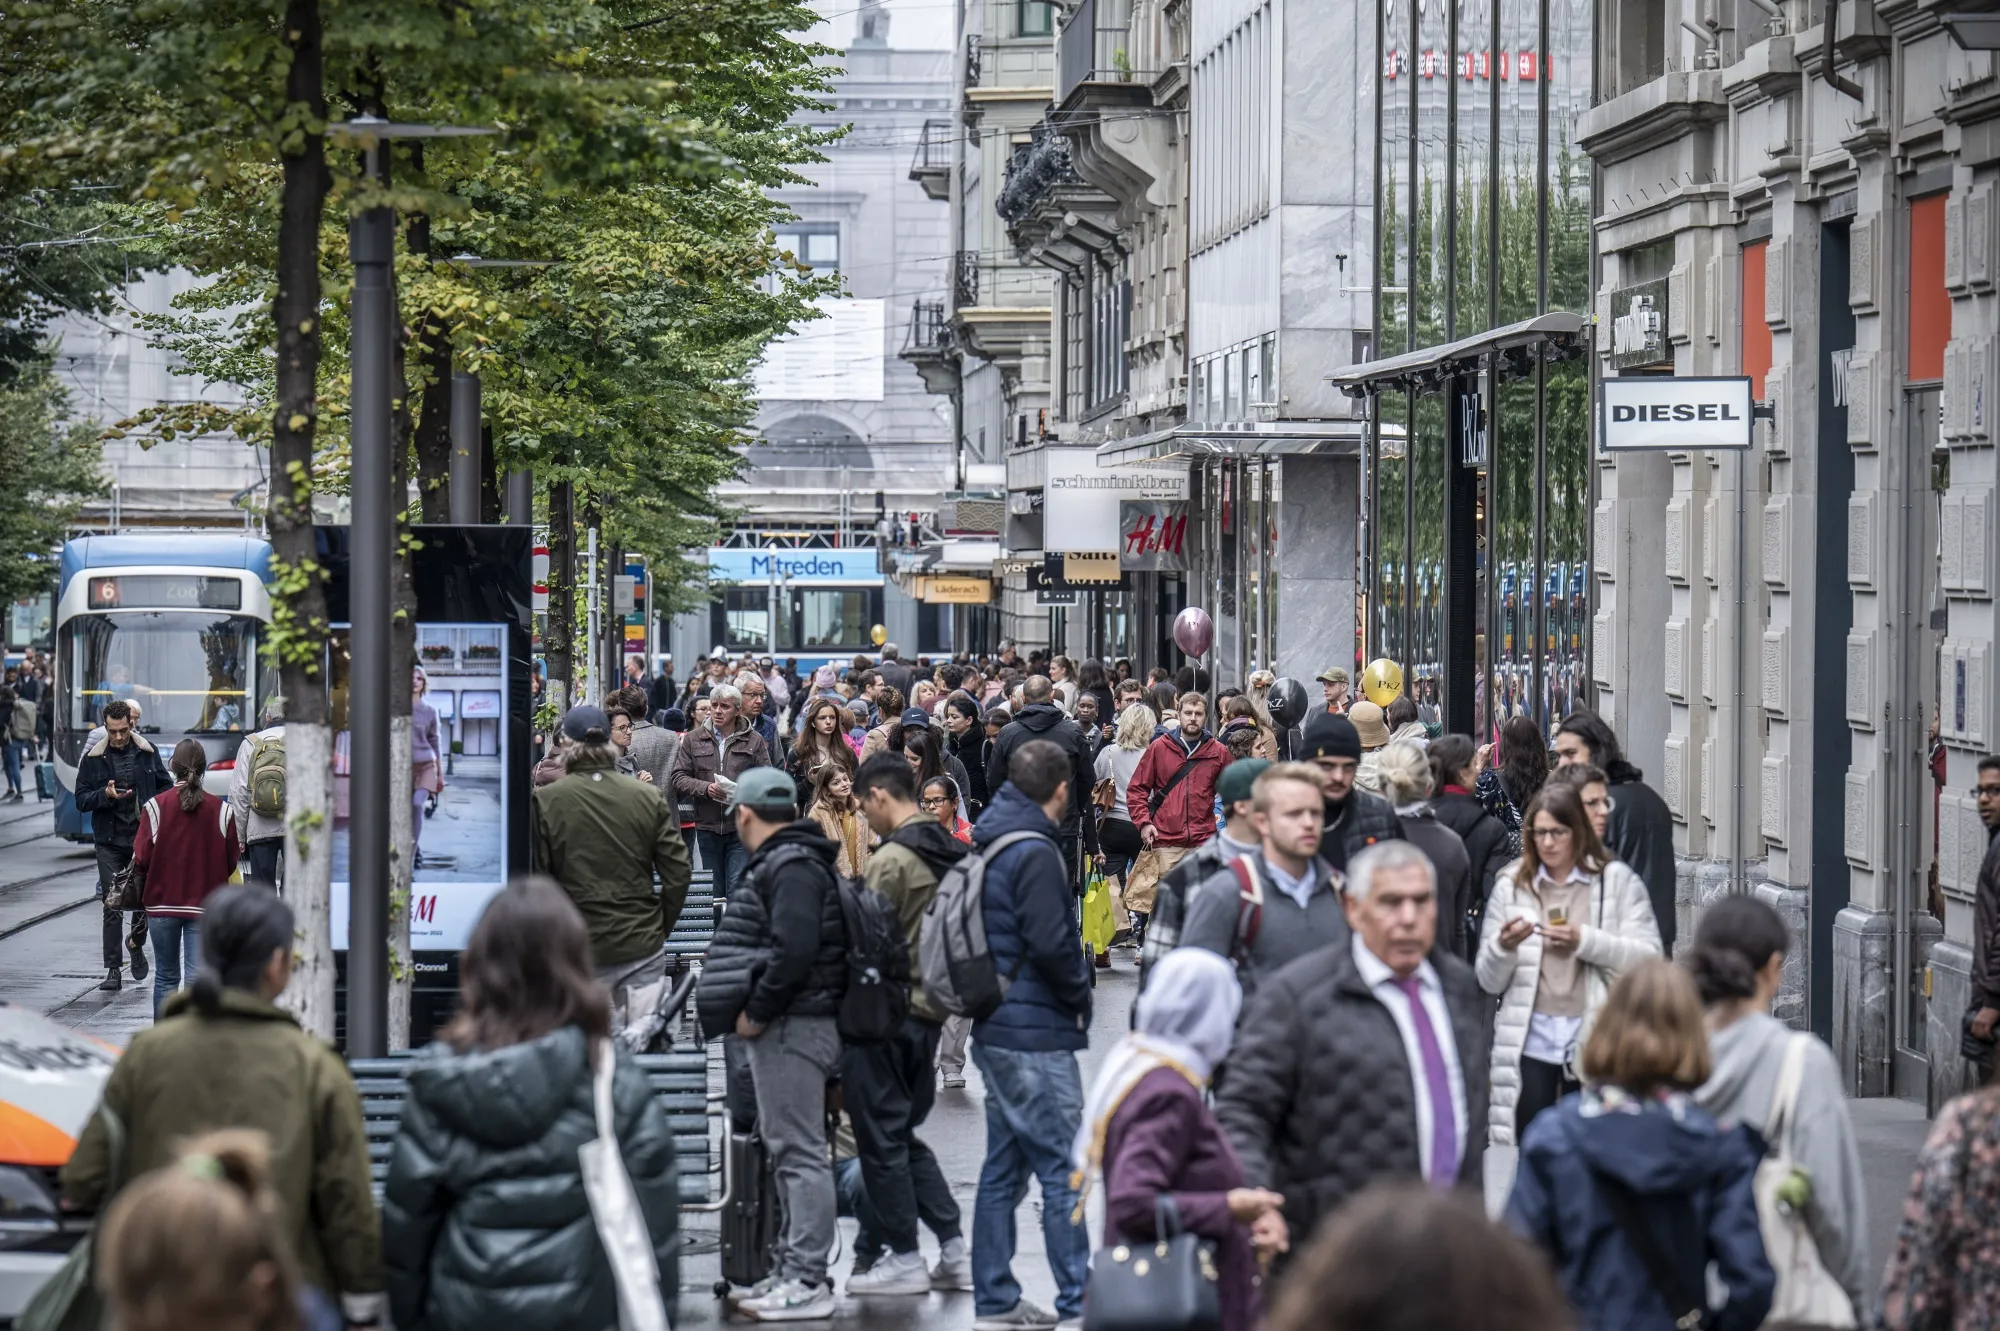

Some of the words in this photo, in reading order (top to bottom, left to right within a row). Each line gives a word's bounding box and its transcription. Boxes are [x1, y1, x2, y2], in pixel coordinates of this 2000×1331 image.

[1612, 403, 1740, 423] DIESEL
[1461, 393, 1478, 463] PKZ
[1051, 474, 1185, 490] schminkbar
[1126, 513, 1187, 556] H&M
[751, 555, 844, 575] Mtreden
[102, 581, 115, 599] 6
[166, 583, 198, 599] Zoo
[935, 584, 980, 594] Läderach
[1377, 680, 1401, 691] PKZ
[414, 962, 449, 972] Channel
